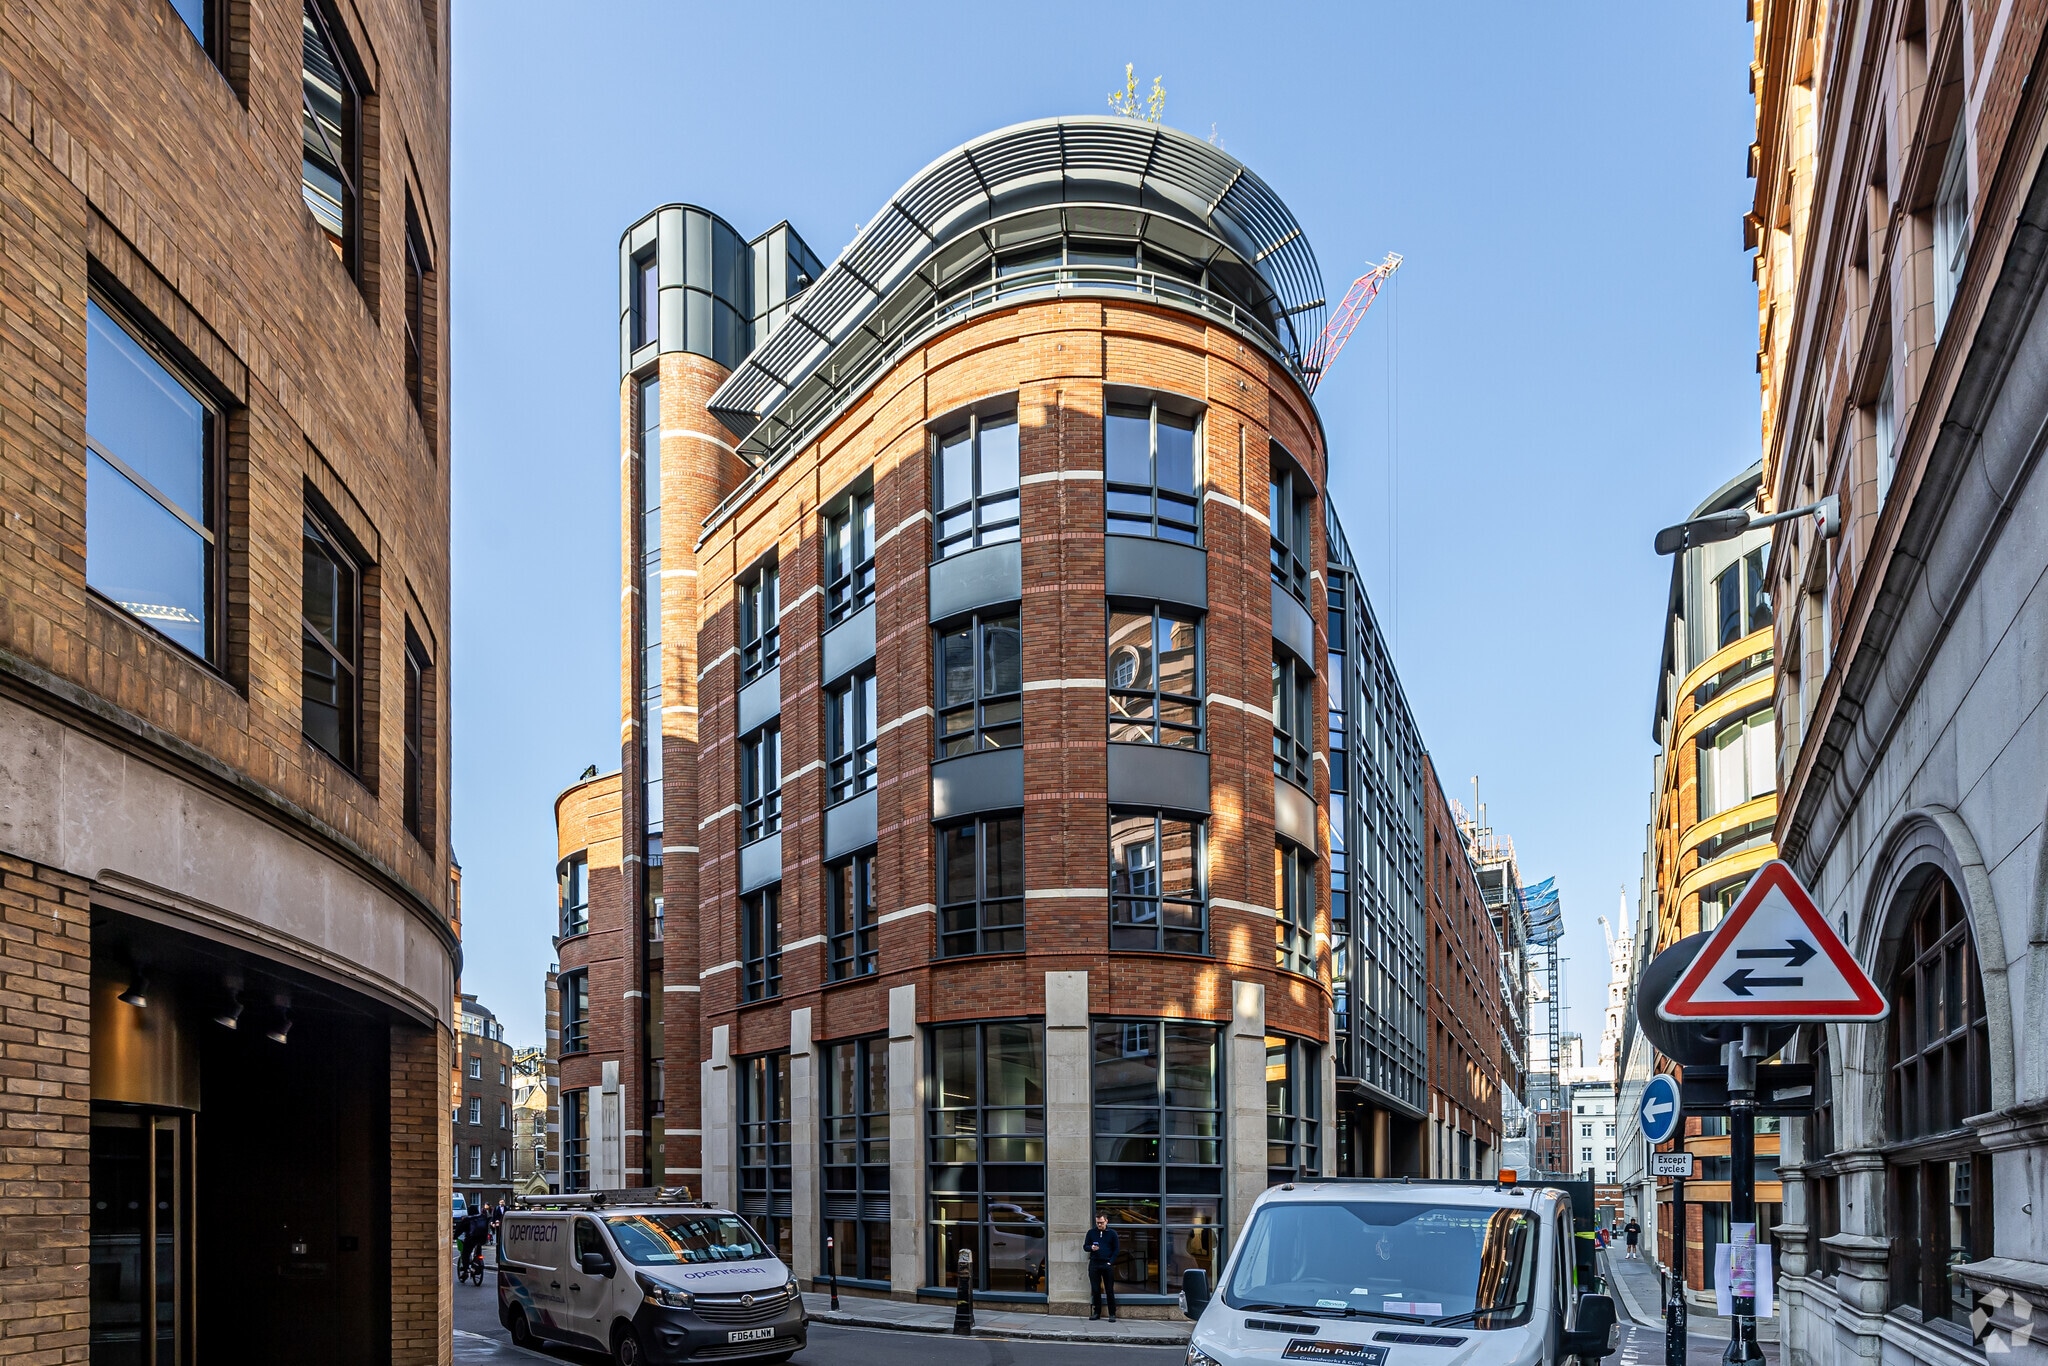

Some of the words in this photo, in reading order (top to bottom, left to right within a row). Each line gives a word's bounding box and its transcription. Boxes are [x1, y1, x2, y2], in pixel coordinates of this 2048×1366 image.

[1658, 1156, 1686, 1165] Except
[1659, 1165, 1685, 1174] cycles
[509, 1222, 557, 1244] openreach
[684, 1267, 766, 1279] openreach
[731, 1330, 753, 1341] FD64
[1293, 1345, 1330, 1354] Julian
[1334, 1348, 1377, 1360] Paving
[1299, 1356, 1340, 1364] Groundworks
